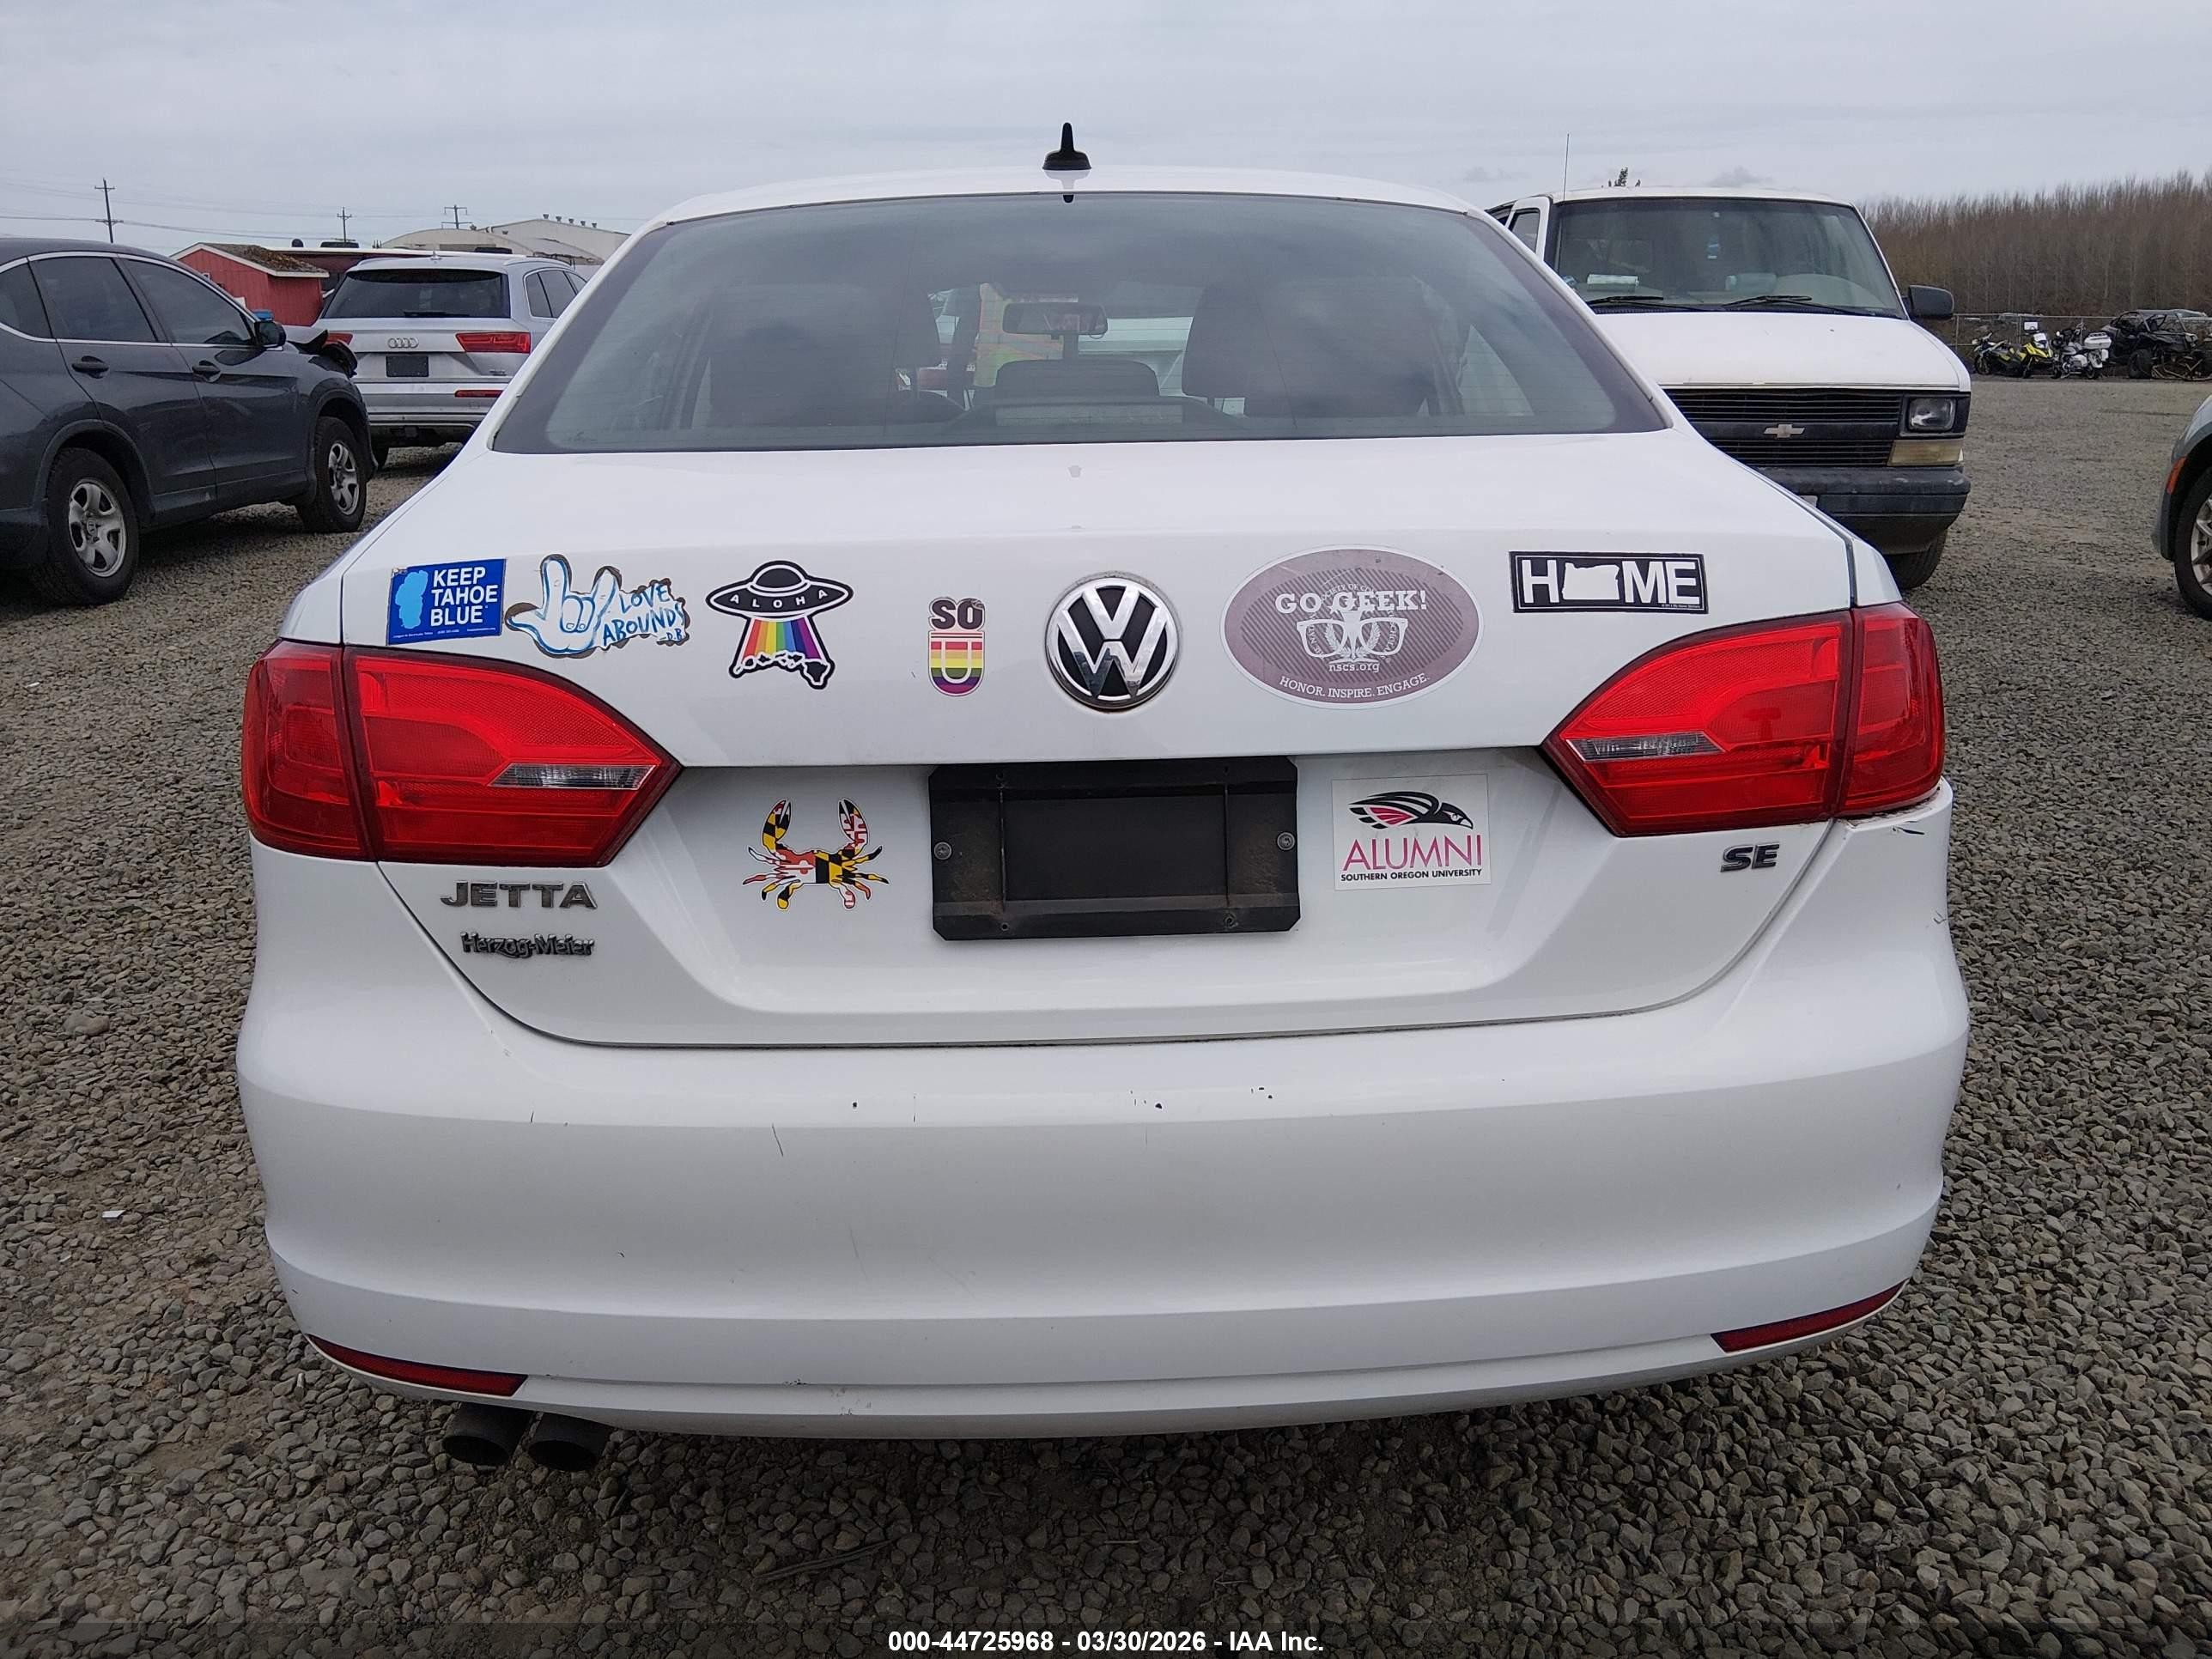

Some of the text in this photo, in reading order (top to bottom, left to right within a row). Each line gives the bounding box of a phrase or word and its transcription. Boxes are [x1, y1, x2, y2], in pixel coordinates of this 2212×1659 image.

[433, 566, 486, 588] KEEP
[430, 584, 499, 607] TAHOE
[618, 584, 671, 614] LOVE
[730, 589, 828, 609] ALOHA
[1274, 592, 1323, 614] GO
[1333, 590, 1427, 612] GEEK!
[430, 605, 483, 627] BLUE
[602, 602, 685, 647] ABOUNDS
[931, 599, 984, 630] SO
[1328, 662, 1380, 672] nscs.org
[1279, 673, 1431, 699] HONOR. INSPIRE. ENGAGE.
[1342, 834, 1483, 872] ALUMNI
[1720, 842, 1780, 872] SE
[1340, 868, 1482, 882] SOUTHERN OREGON UNIVERSITY
[440, 879, 599, 909] JETTA
[459, 932, 595, 959] Herzog-Meier
